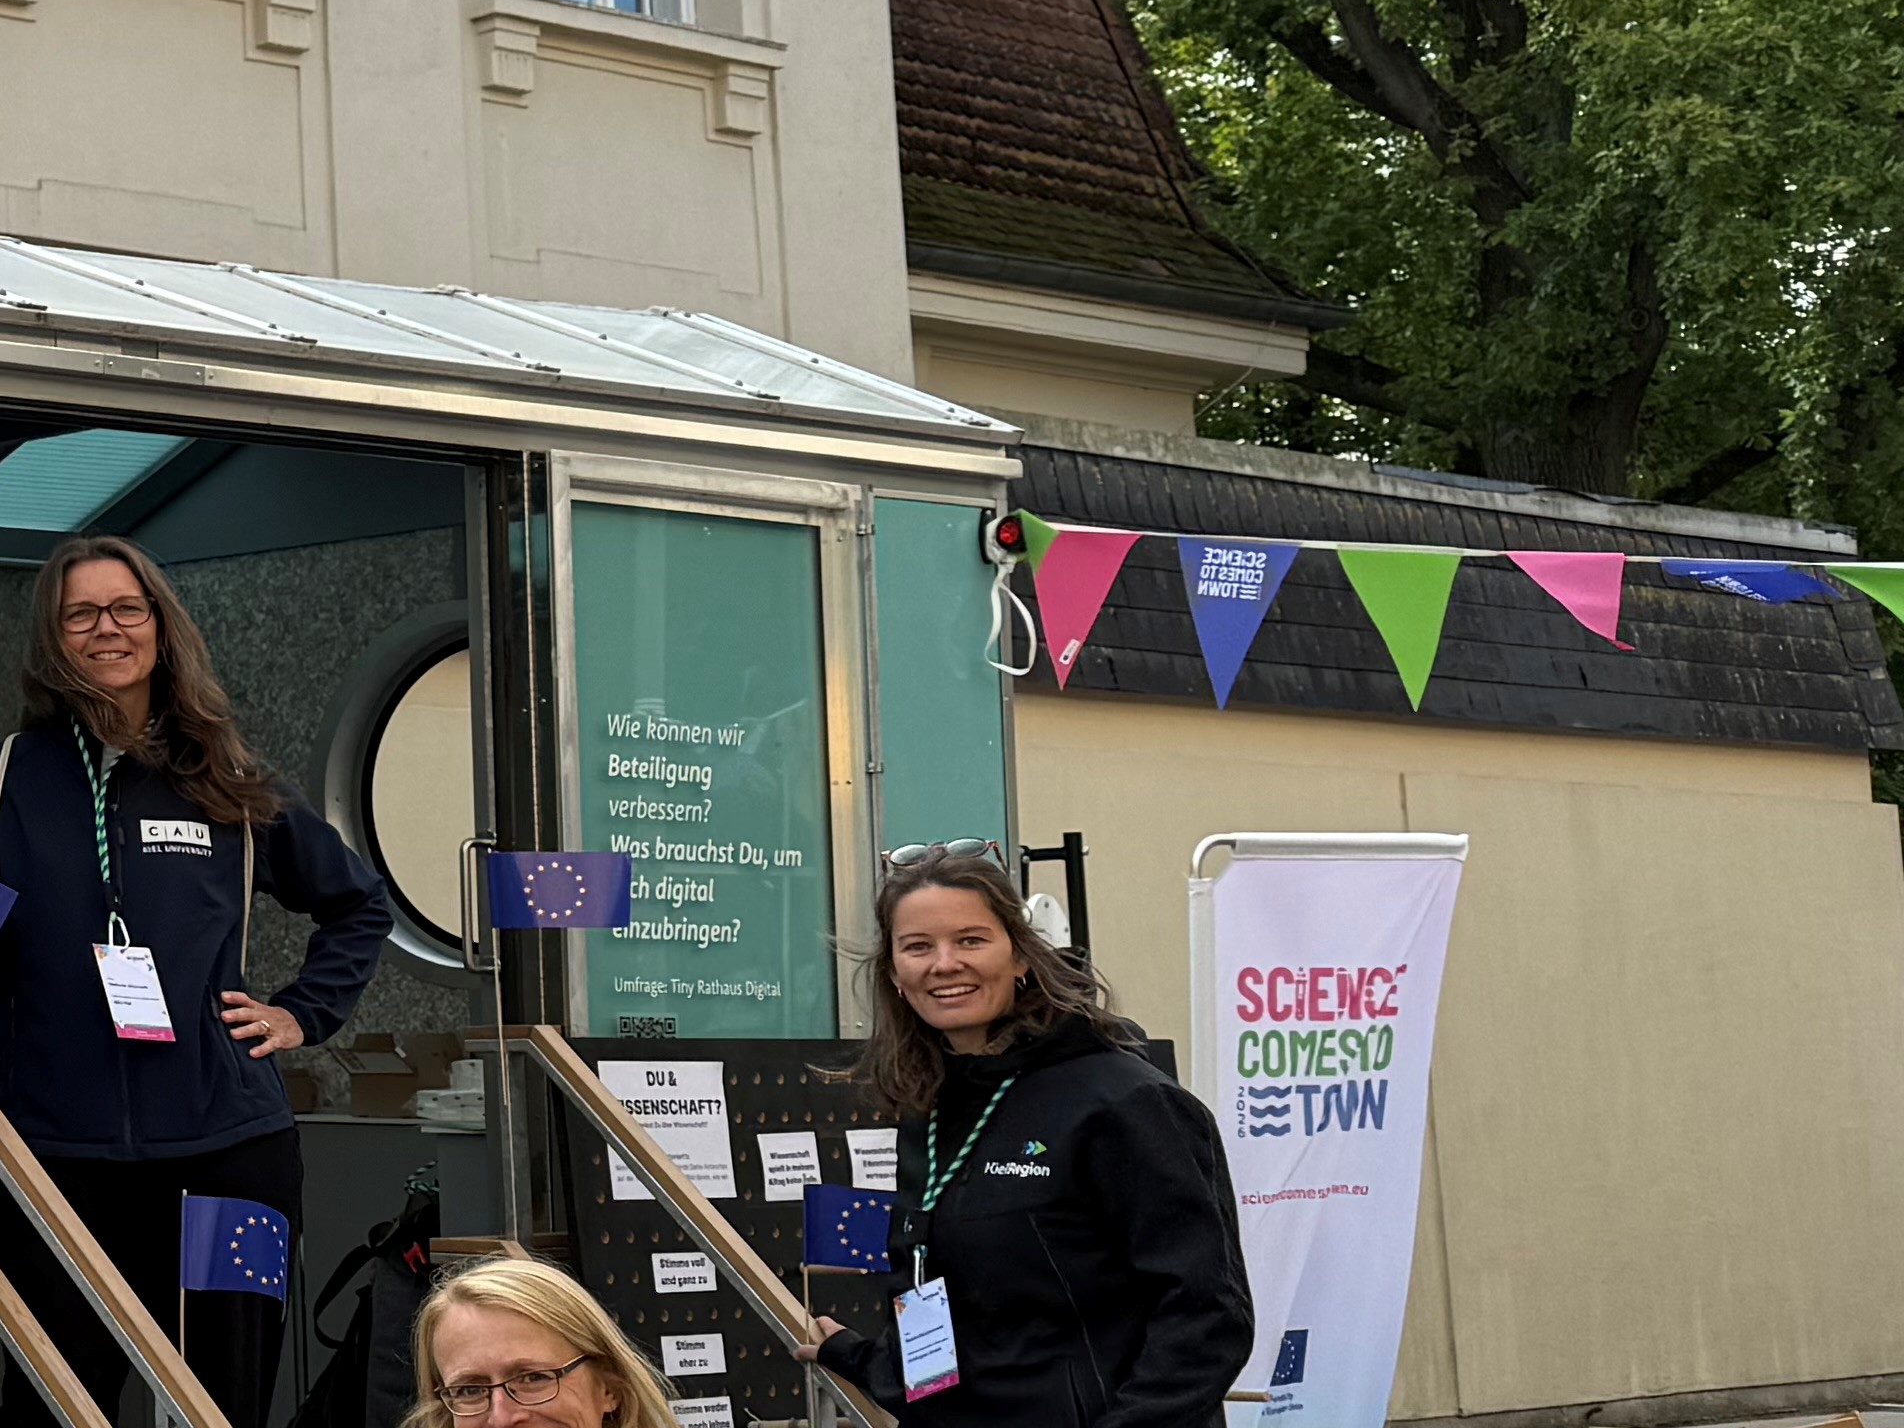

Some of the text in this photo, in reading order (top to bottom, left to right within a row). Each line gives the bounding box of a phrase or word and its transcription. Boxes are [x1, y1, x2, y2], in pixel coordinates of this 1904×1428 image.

[608, 714, 745, 747] Wie können wir
[608, 755, 712, 790] Beteiligung
[609, 795, 711, 823] verbessern?
[611, 834, 802, 870] Was brauchst Du, um
[629, 876, 714, 907] ch digital
[612, 918, 741, 948] einzubringen?
[614, 977, 781, 1001] Umfrage: Tiny Rathaus Digital
[646, 1071, 677, 1086] DU &
[617, 1099, 721, 1115] ISSENSCHAFT?
